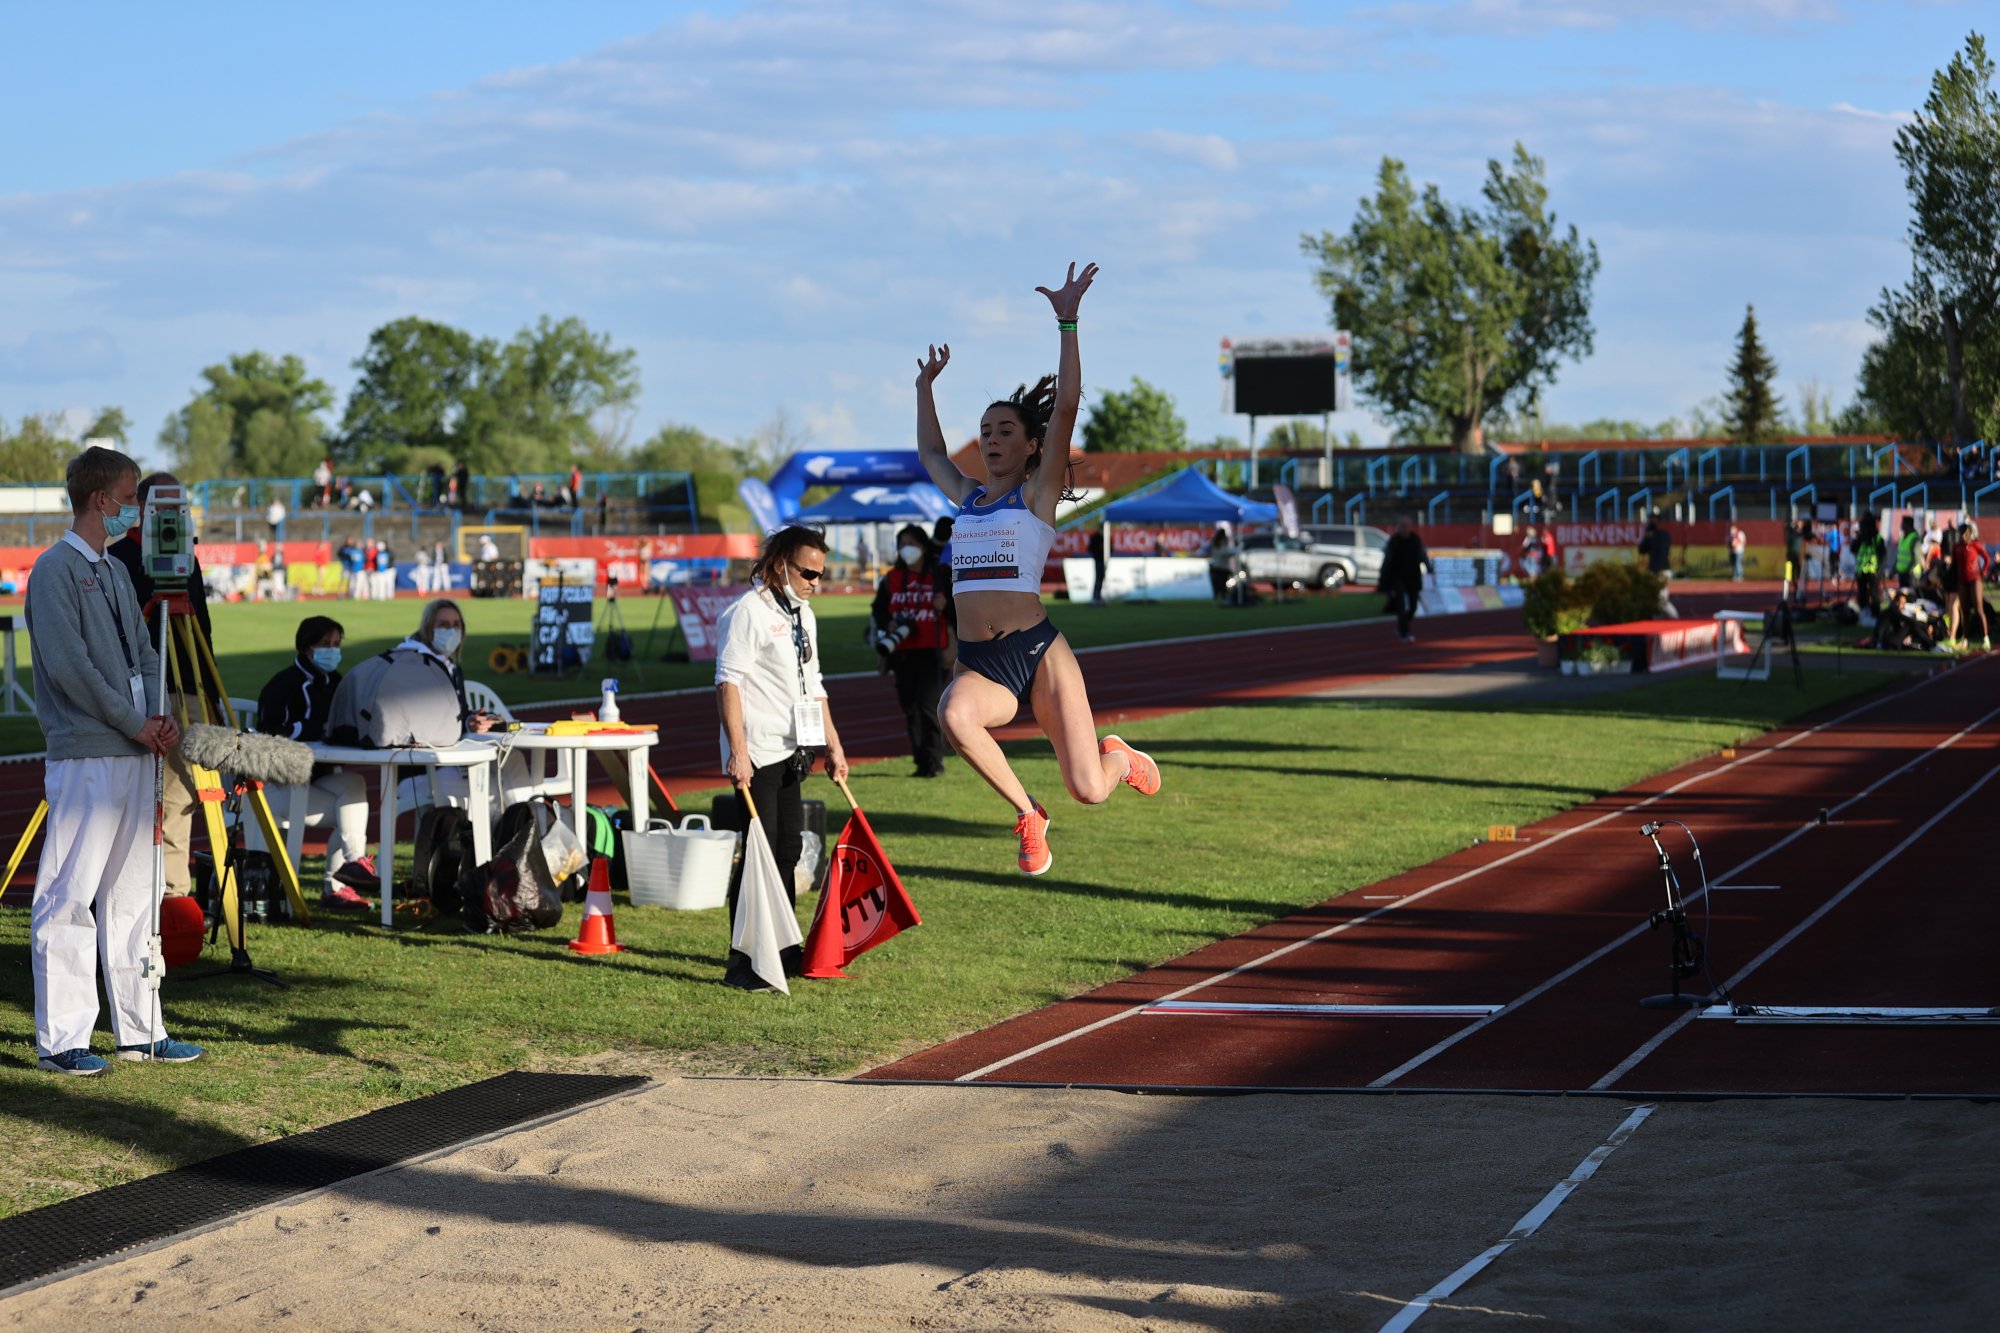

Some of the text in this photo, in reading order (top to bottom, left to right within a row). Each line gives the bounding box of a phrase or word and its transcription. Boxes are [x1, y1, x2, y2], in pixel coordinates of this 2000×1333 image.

[954, 529, 1015, 540] Sparkasse Dessau
[952, 551, 1014, 568] otopoulou
[964, 569, 1015, 579] ANHALT 2021
[1499, 829, 1512, 838] 34
